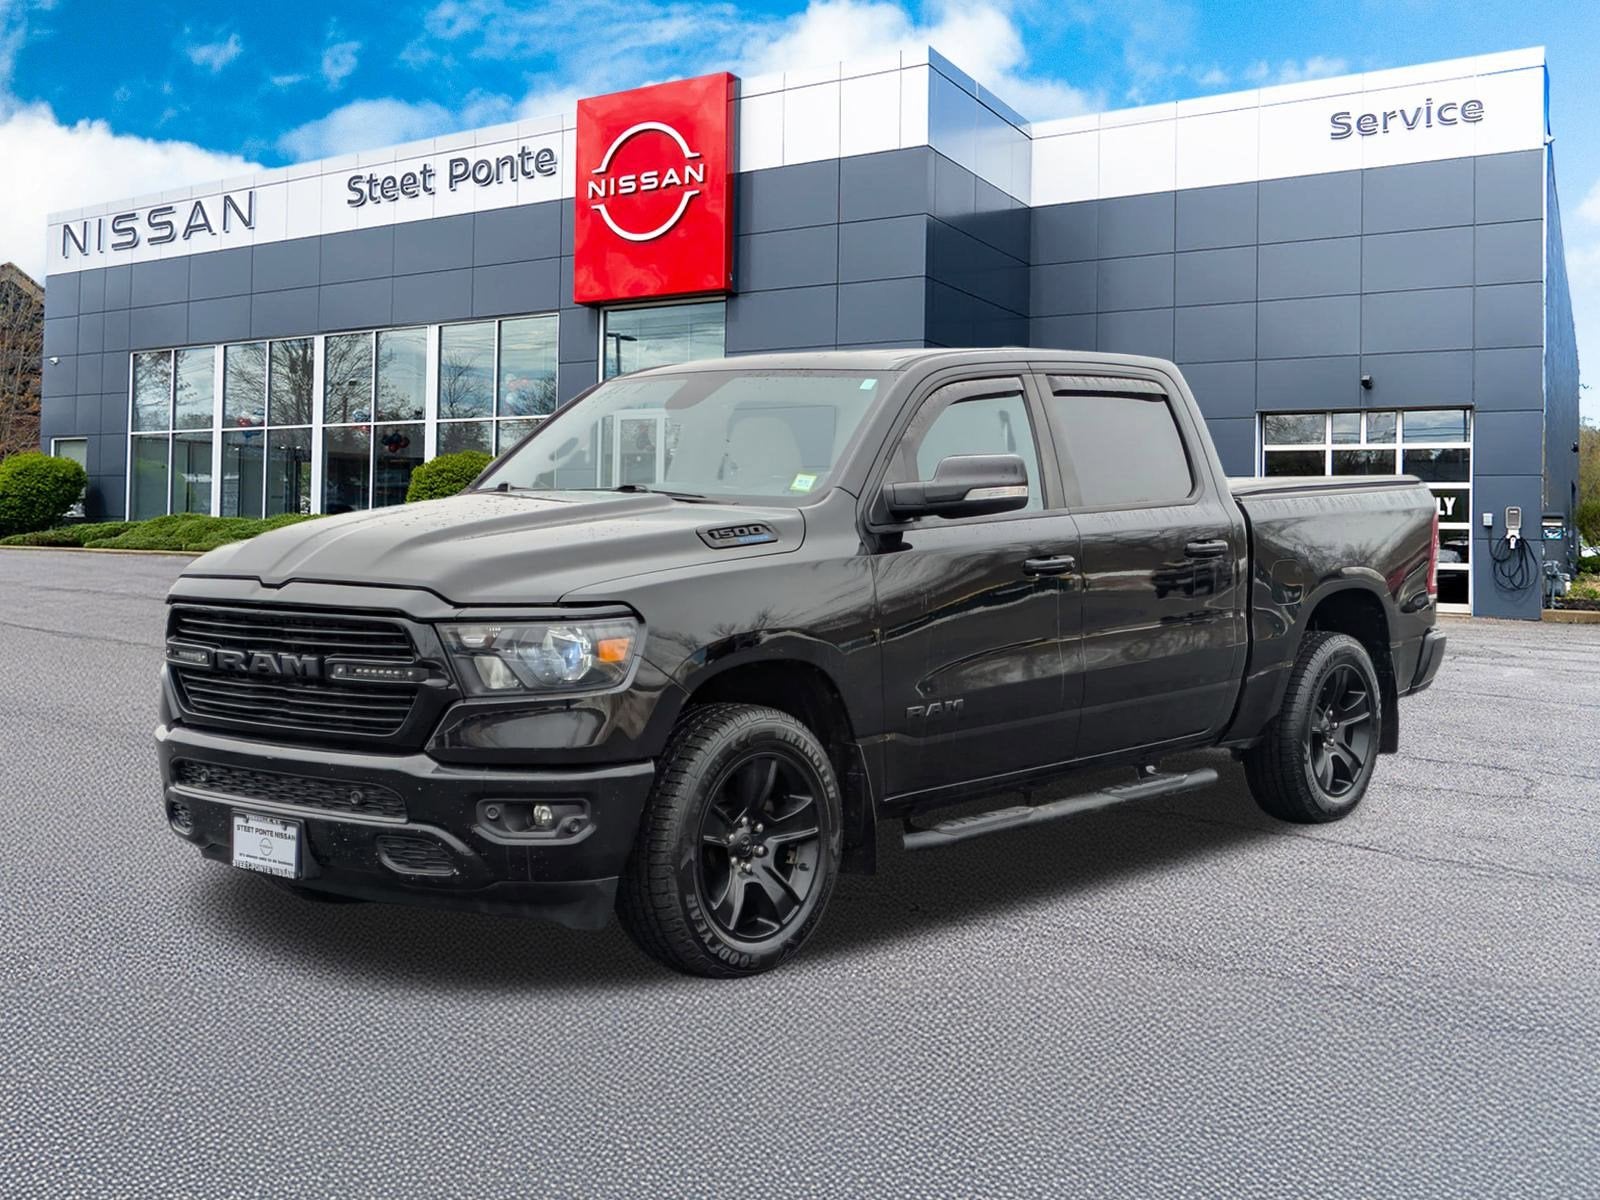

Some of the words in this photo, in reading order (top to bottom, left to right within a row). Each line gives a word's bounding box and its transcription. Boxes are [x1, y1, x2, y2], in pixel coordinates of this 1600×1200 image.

[1330, 97, 1485, 140] Service
[347, 163, 436, 207] Steet
[449, 145, 558, 192] Ponte
[587, 162, 705, 200] NISSAN
[62, 190, 256, 259] NISSAN
[707, 524, 765, 540] 1500
[216, 648, 320, 678] RAM
[905, 698, 965, 722] RAM
[236, 823, 255, 834] STEET
[255, 826, 274, 838] PONTE
[274, 830, 297, 841] NISSAN
